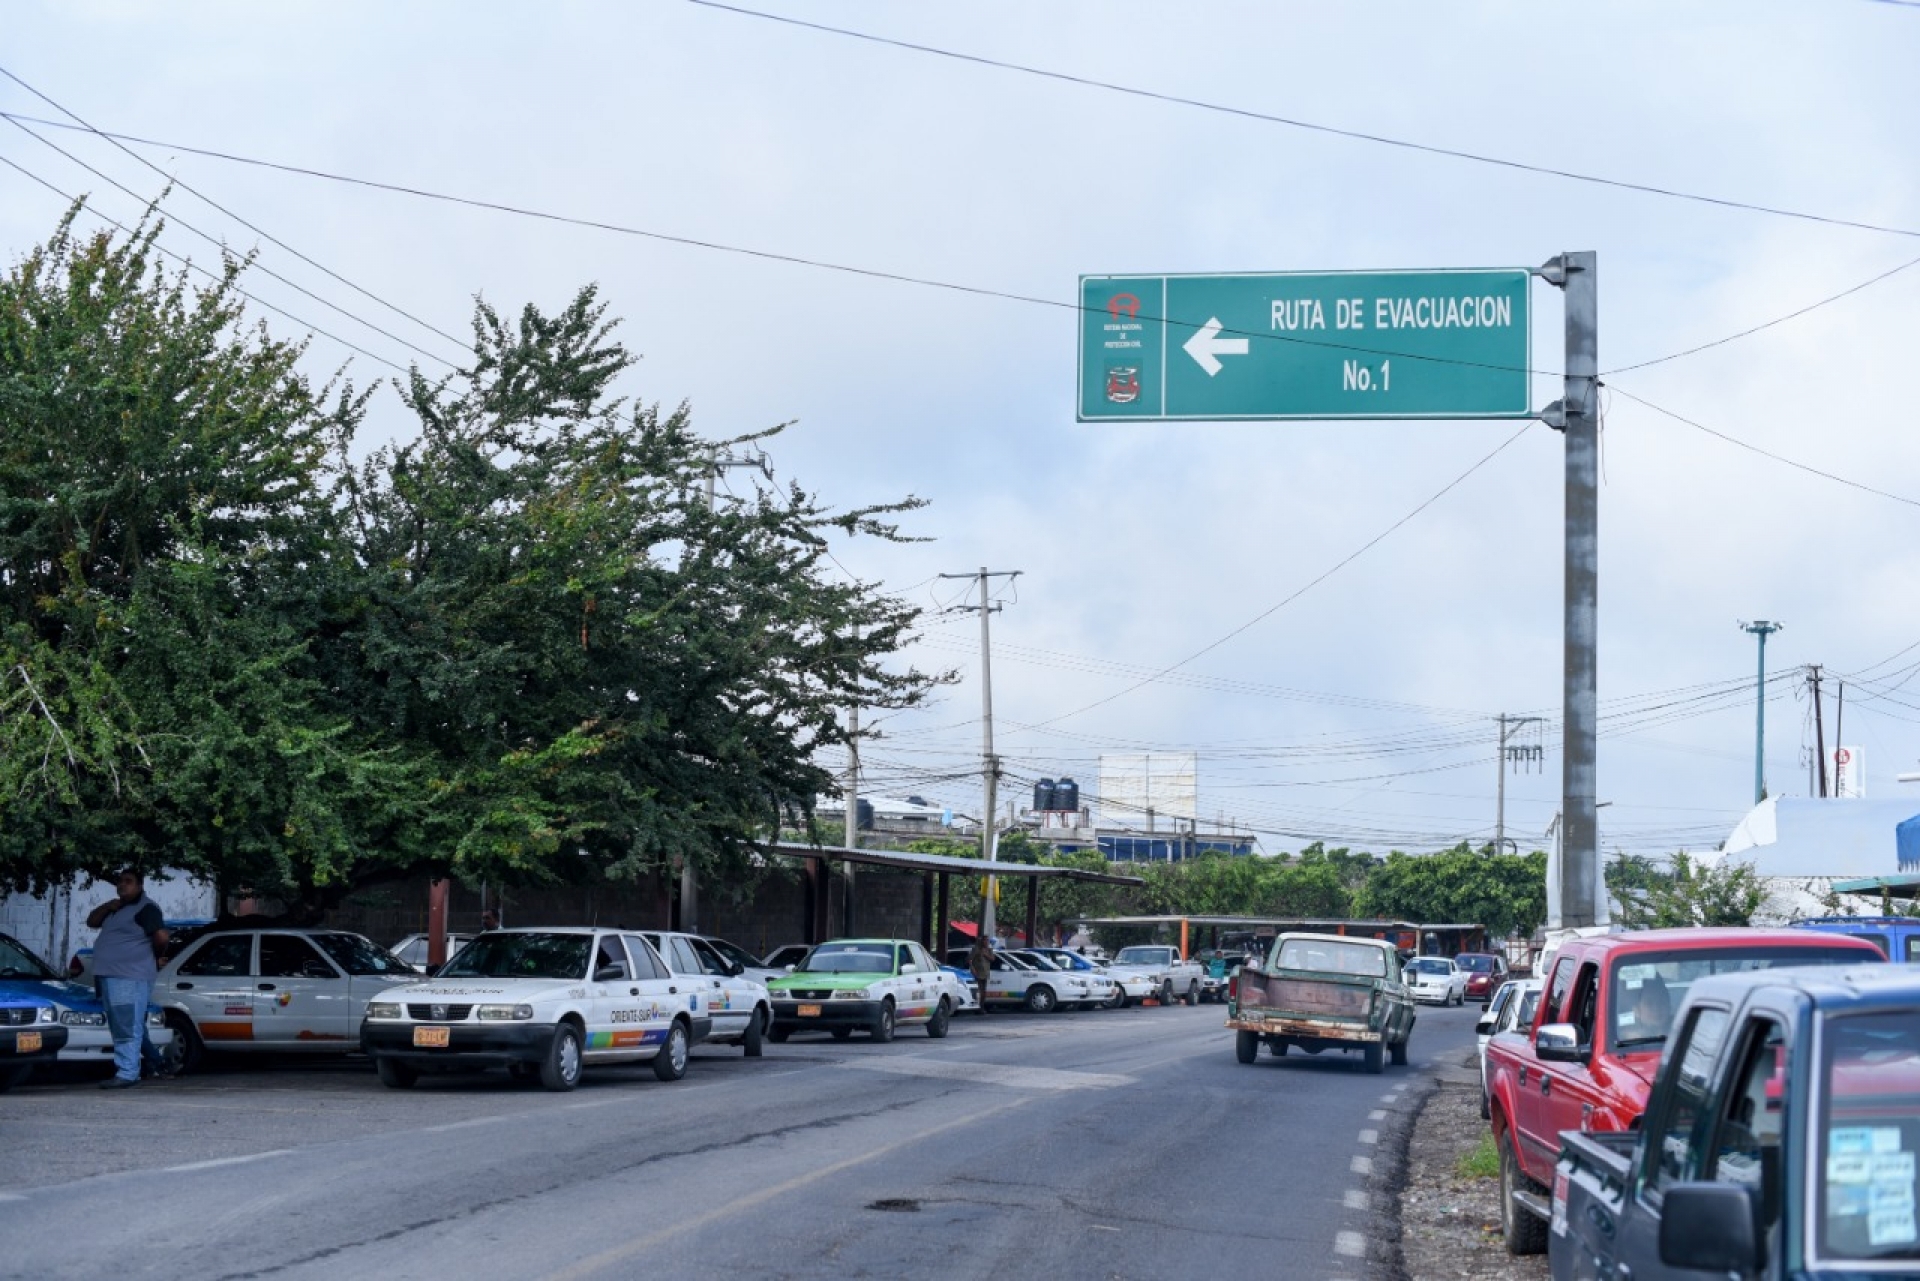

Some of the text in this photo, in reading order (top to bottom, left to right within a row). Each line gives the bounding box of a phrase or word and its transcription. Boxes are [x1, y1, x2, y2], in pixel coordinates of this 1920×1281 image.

[1271, 295, 1512, 331] RUTA DE EVACUACION
